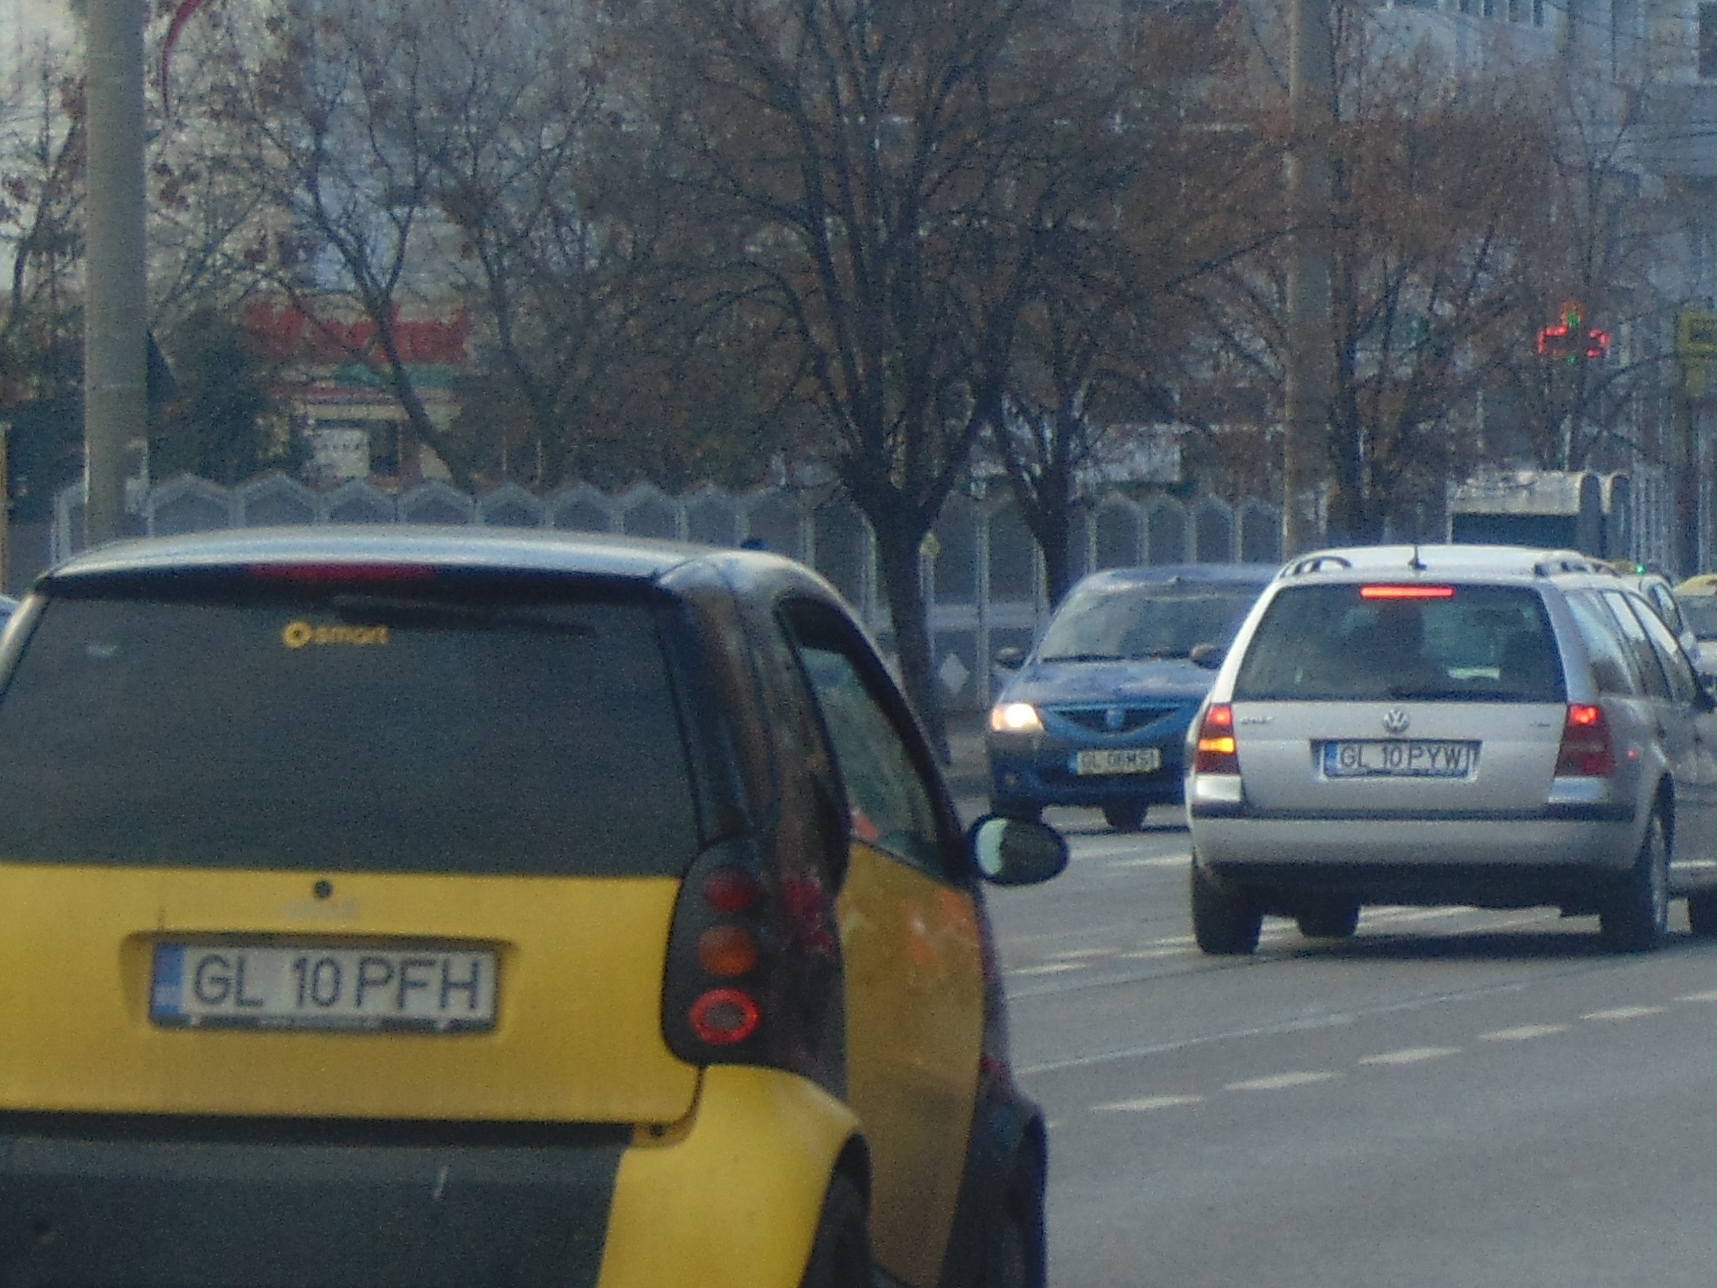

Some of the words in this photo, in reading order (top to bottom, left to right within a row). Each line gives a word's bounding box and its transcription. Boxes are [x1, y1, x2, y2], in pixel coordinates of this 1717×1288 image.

[1340, 745, 1368, 768] GL
[1382, 745, 1400, 769] 10
[1407, 745, 1463, 770] PYW
[194, 953, 264, 1008] GL
[291, 955, 343, 1009] 10
[355, 955, 479, 1011] PFH
